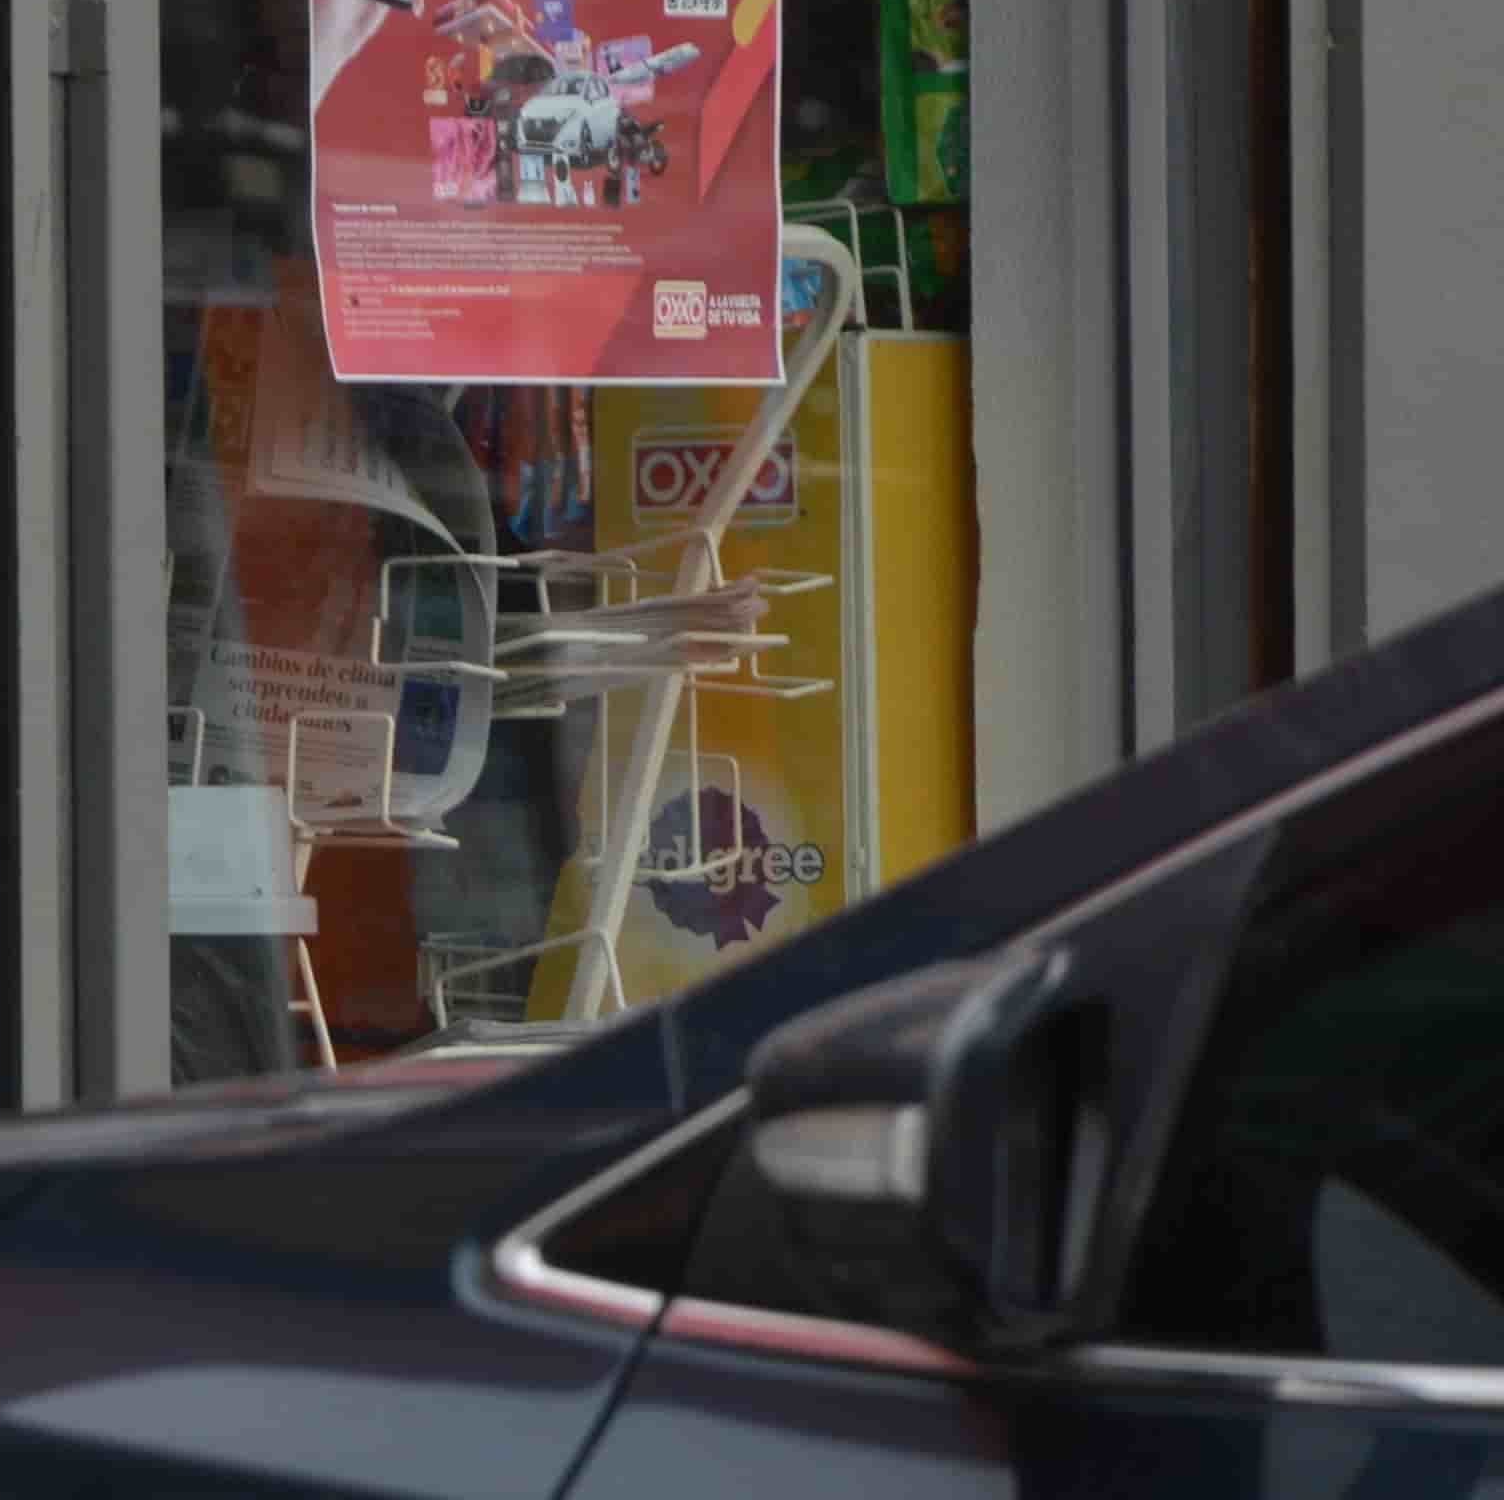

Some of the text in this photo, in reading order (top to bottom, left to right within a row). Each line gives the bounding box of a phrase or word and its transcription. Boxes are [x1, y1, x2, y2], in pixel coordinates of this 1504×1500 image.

[639, 448, 790, 503] OXO
[307, 658, 330, 681] de
[232, 701, 353, 733] ciudaanos
